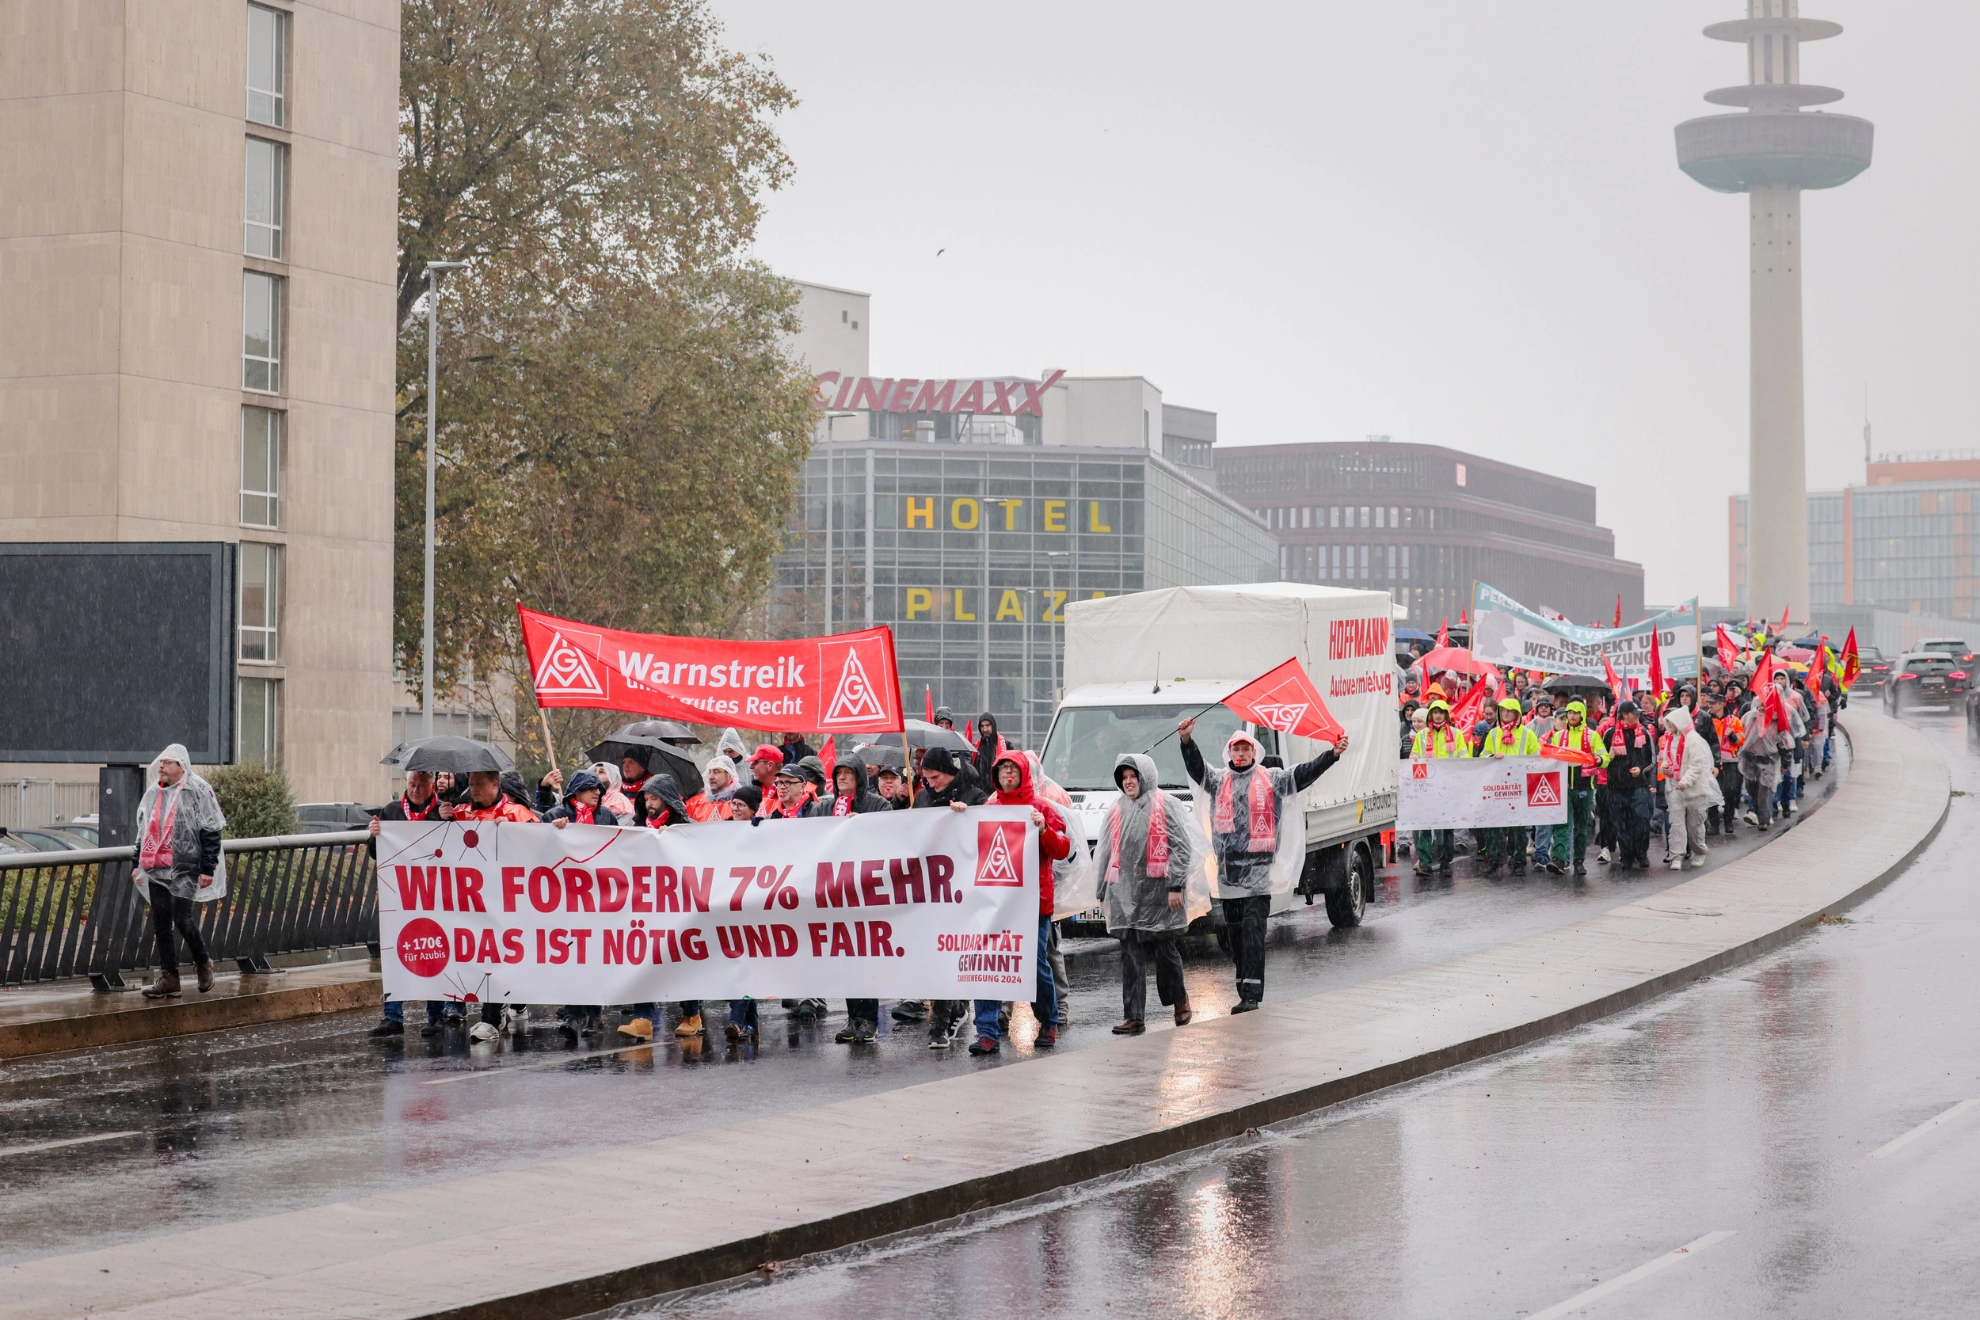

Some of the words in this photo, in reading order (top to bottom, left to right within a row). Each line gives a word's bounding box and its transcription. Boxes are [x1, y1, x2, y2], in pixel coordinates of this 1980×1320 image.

[813, 369, 1067, 417] CINEMAXX
[906, 497, 1112, 533] HOTEL
[906, 588, 1108, 622] PLAZ
[1329, 617, 1389, 660] HOFFMANN
[1559, 637, 1635, 657] RESPEKT
[618, 650, 805, 688] Warnstreik
[1330, 671, 1392, 697] Autovermietung
[745, 695, 803, 715] Recht
[1483, 783, 1522, 792] SOLIDARITÄT
[1494, 790, 1522, 798] GEWINNT
[394, 865, 487, 913] WIR
[501, 866, 714, 913] FORDERN
[729, 864, 800, 912] 7%
[815, 854, 963, 909] MEHR.
[453, 927, 524, 964] DAS
[536, 928, 592, 965] IST
[603, 919, 709, 965] NÖTIG
[716, 924, 798, 959] UND
[808, 920, 905, 958] FAIR.
[937, 929, 1023, 952] SOLIDARITÄT
[404, 952, 418, 962] für
[420, 950, 446, 960] Azubis
[958, 954, 1023, 973] GEWINNT
[1001, 975, 1022, 984] 2024
